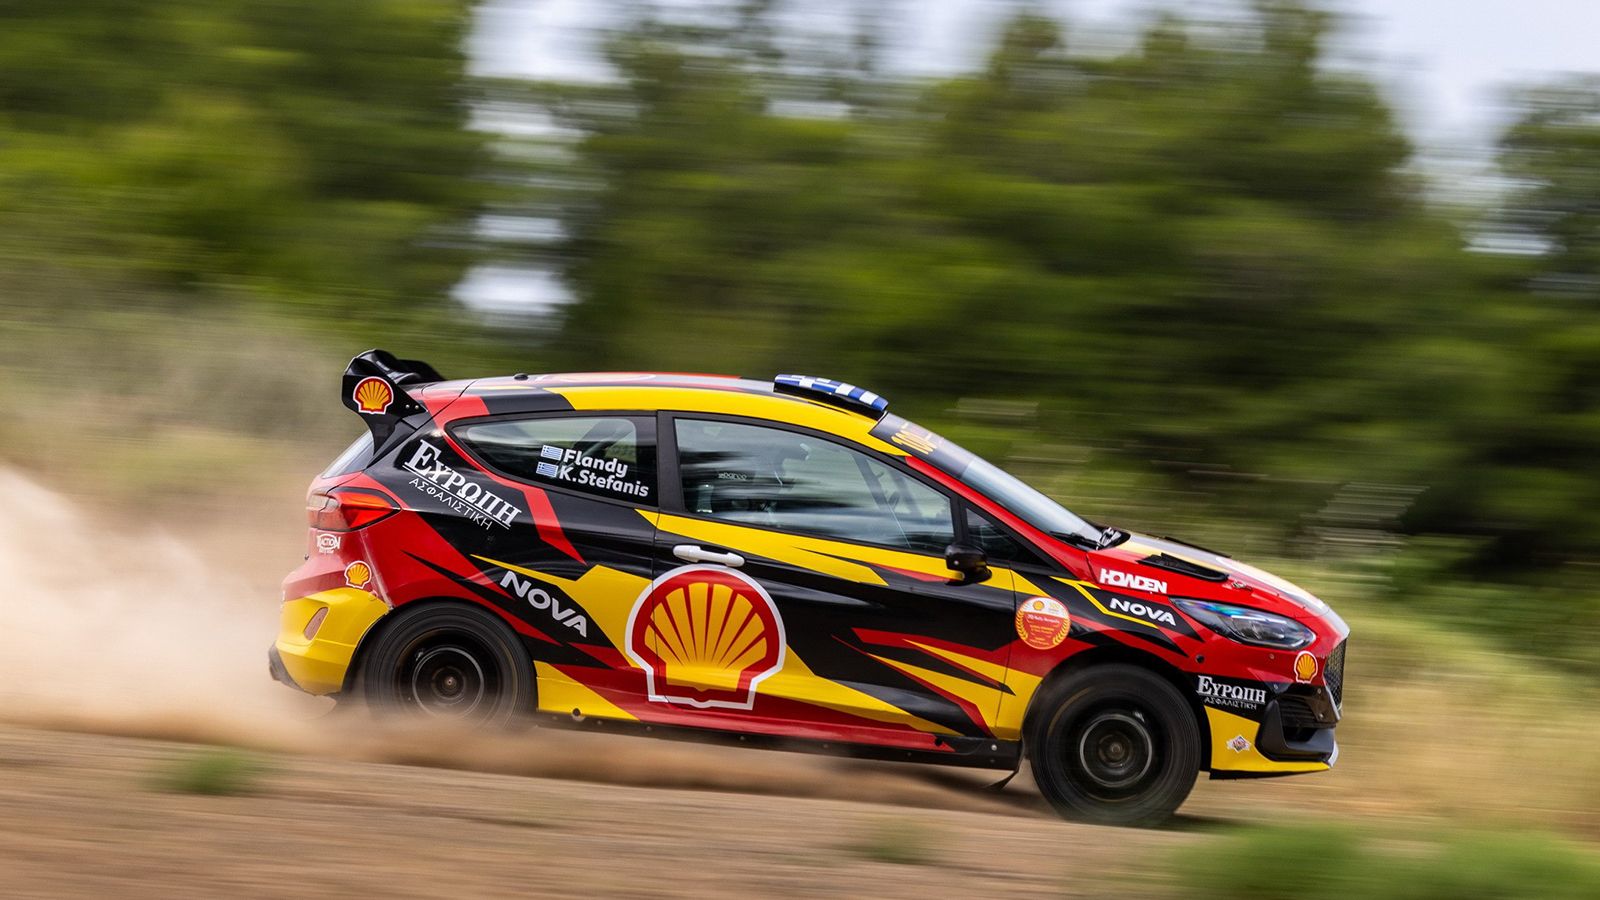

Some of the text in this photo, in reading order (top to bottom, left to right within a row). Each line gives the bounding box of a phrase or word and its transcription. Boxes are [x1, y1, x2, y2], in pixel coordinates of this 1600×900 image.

[563, 448, 628, 478] Flandy
[404, 439, 522, 527] ΕΥΡΩΠΗ
[559, 465, 649, 497] K.Stefanis
[409, 478, 493, 530] ΑΣΦΑΛΙΣΤΙΚΗ
[1100, 568, 1168, 594] HOWDEN
[500, 570, 587, 638] NOVA
[1109, 597, 1176, 626] NOVA
[1196, 674, 1266, 704] ΕΥΡΩΠΗ
